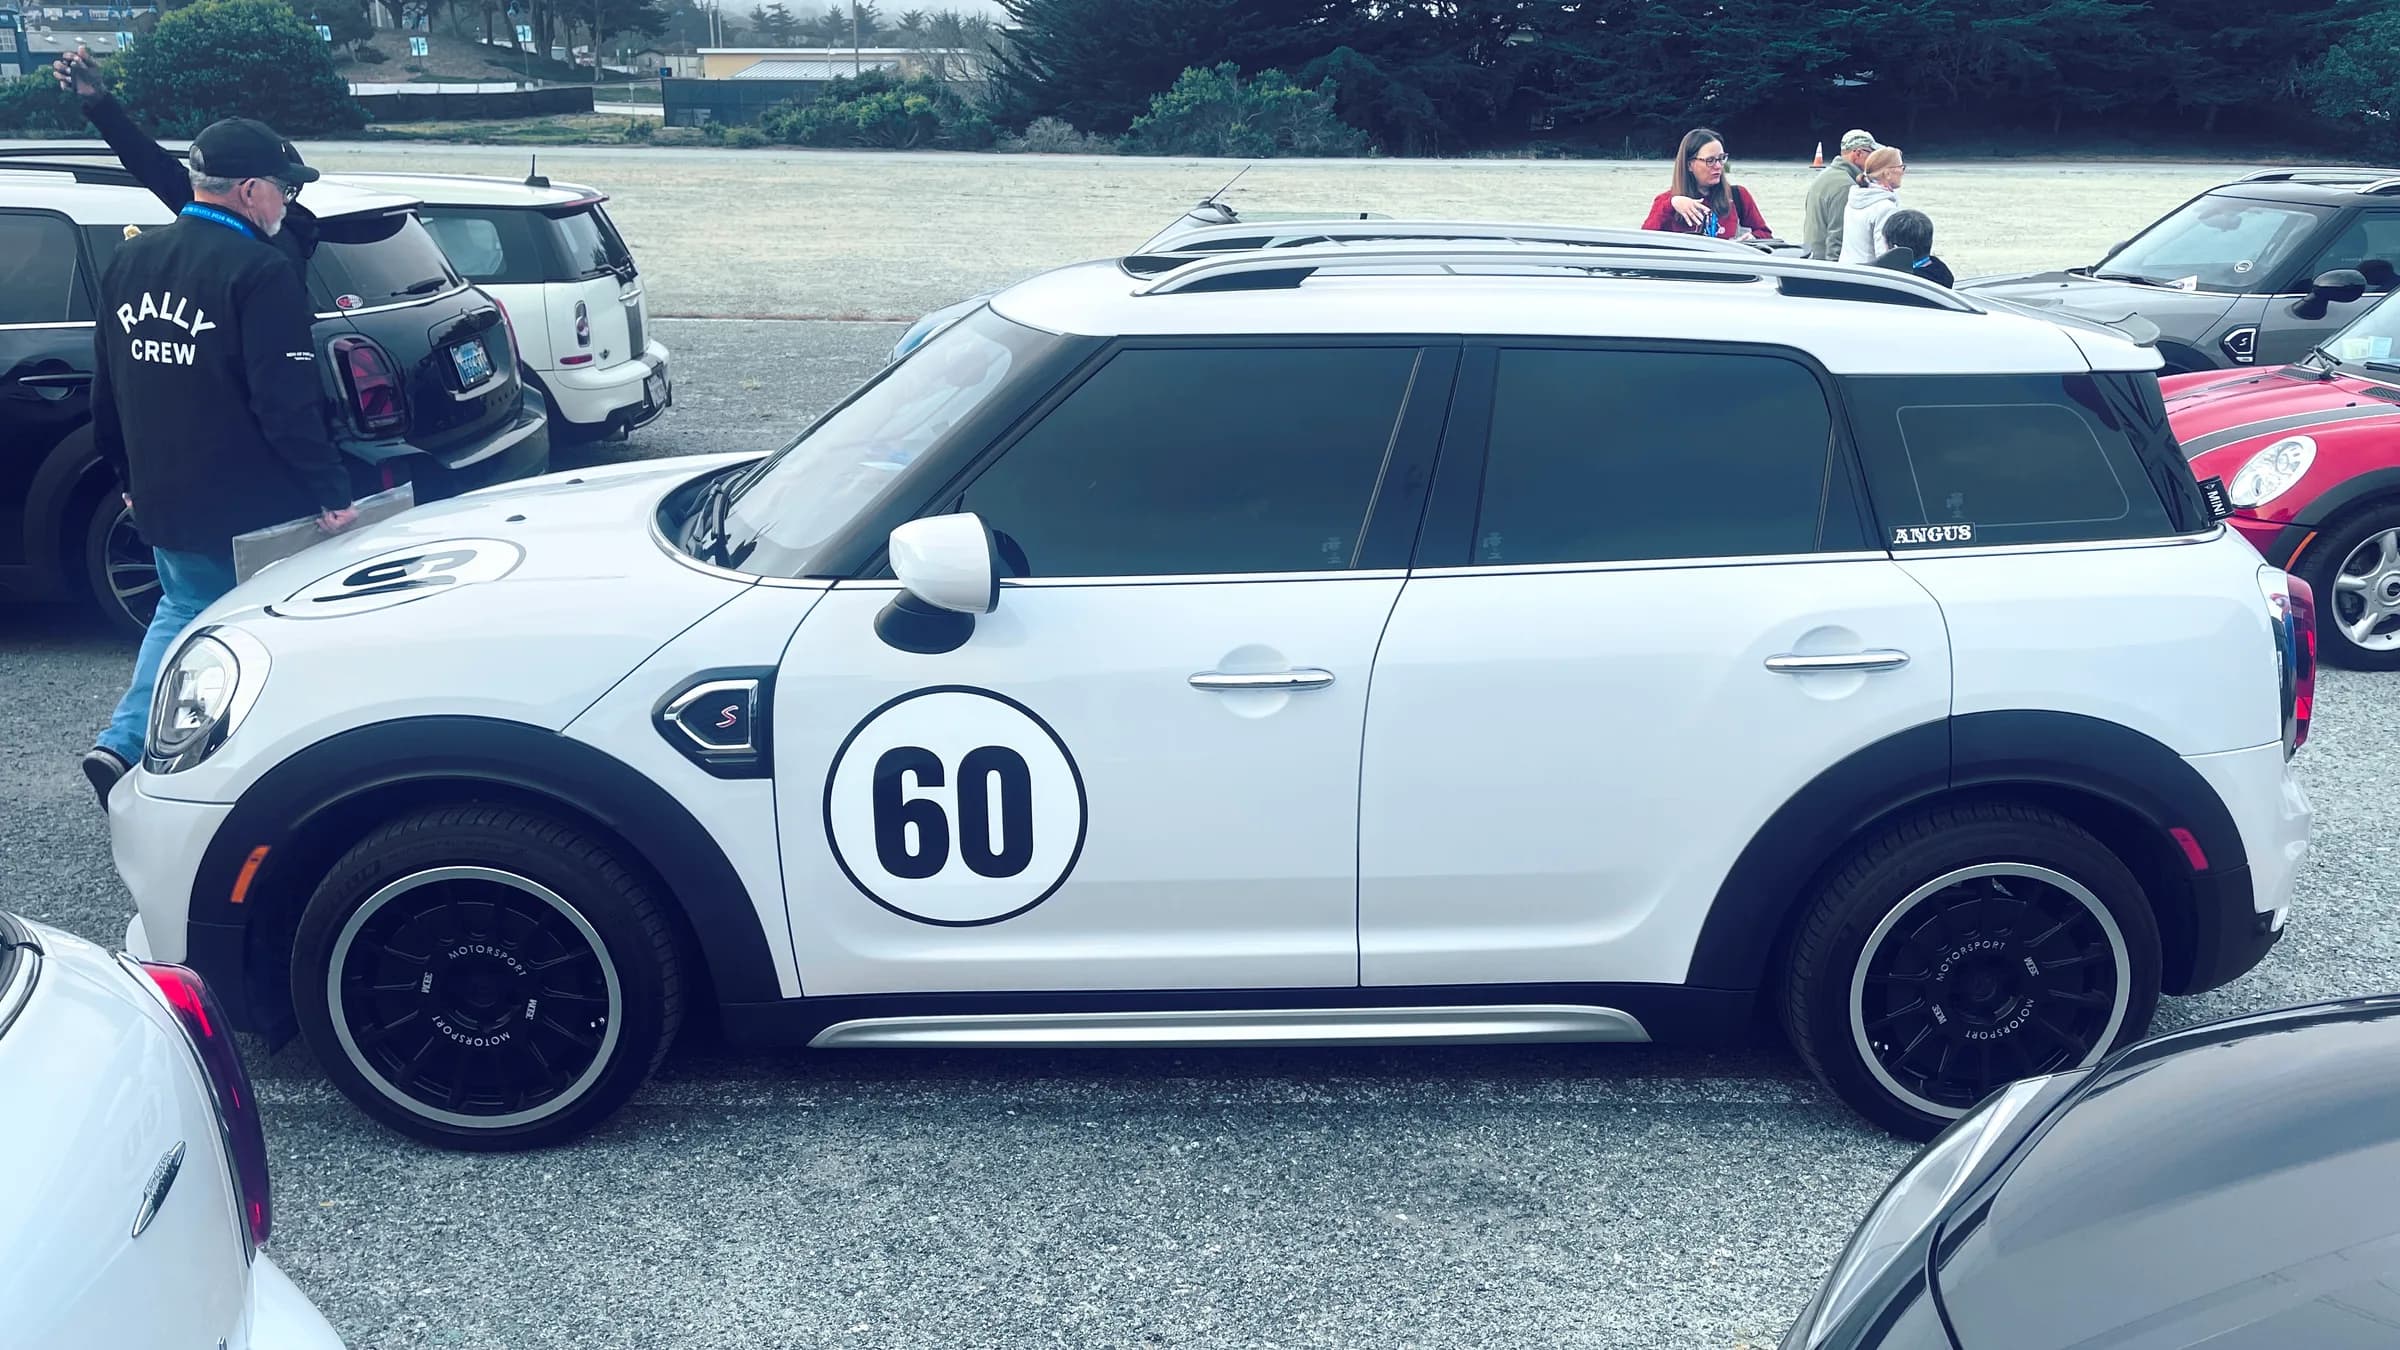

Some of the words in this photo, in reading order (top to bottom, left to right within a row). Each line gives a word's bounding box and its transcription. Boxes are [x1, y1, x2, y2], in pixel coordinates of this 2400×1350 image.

[116, 291, 217, 338] RALLY
[131, 338, 196, 366] CREW
[2207, 490, 2226, 516] MINI
[1893, 524, 1972, 544] ANGUS
[715, 704, 739, 729] S
[872, 745, 1034, 879] 60
[448, 944, 527, 976] MOTORSPORT
[1935, 940, 2006, 982] MOTORSPORT
[431, 1015, 511, 1046] MOTORSPORT
[1965, 998, 2035, 1040] MOTORSPORT
